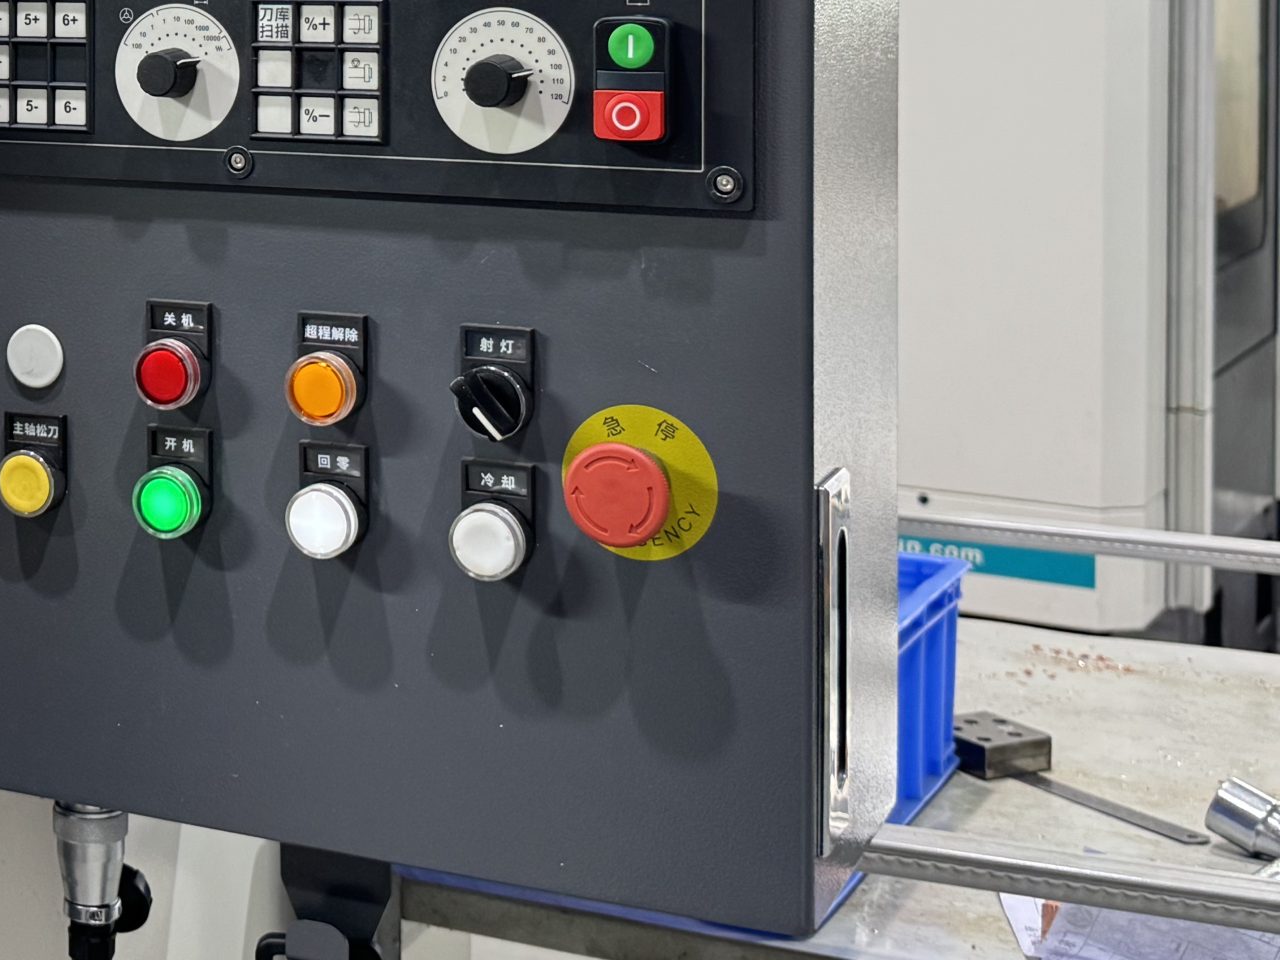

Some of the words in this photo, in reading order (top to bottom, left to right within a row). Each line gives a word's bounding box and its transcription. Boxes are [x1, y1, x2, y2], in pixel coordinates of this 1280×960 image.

[24, 14, 40, 25] 5+
[62, 15, 78, 26] 6+
[260, 7, 289, 22] 刀库
[260, 23, 289, 39] 扫描
[305, 17, 330, 31] %+
[26, 100, 38, 111] 5-
[64, 102, 76, 113] 6-
[164, 312, 194, 327] 关机
[304, 325, 358, 343] 超程解除
[480, 337, 515, 355] 射灯
[13, 422, 59, 439] 主轴松刀
[602, 416, 679, 441] 急停
[165, 437, 194, 453] 开机
[318, 454, 350, 471] 回零
[481, 473, 515, 490] 冷却
[639, 503, 700, 547] ENCY
